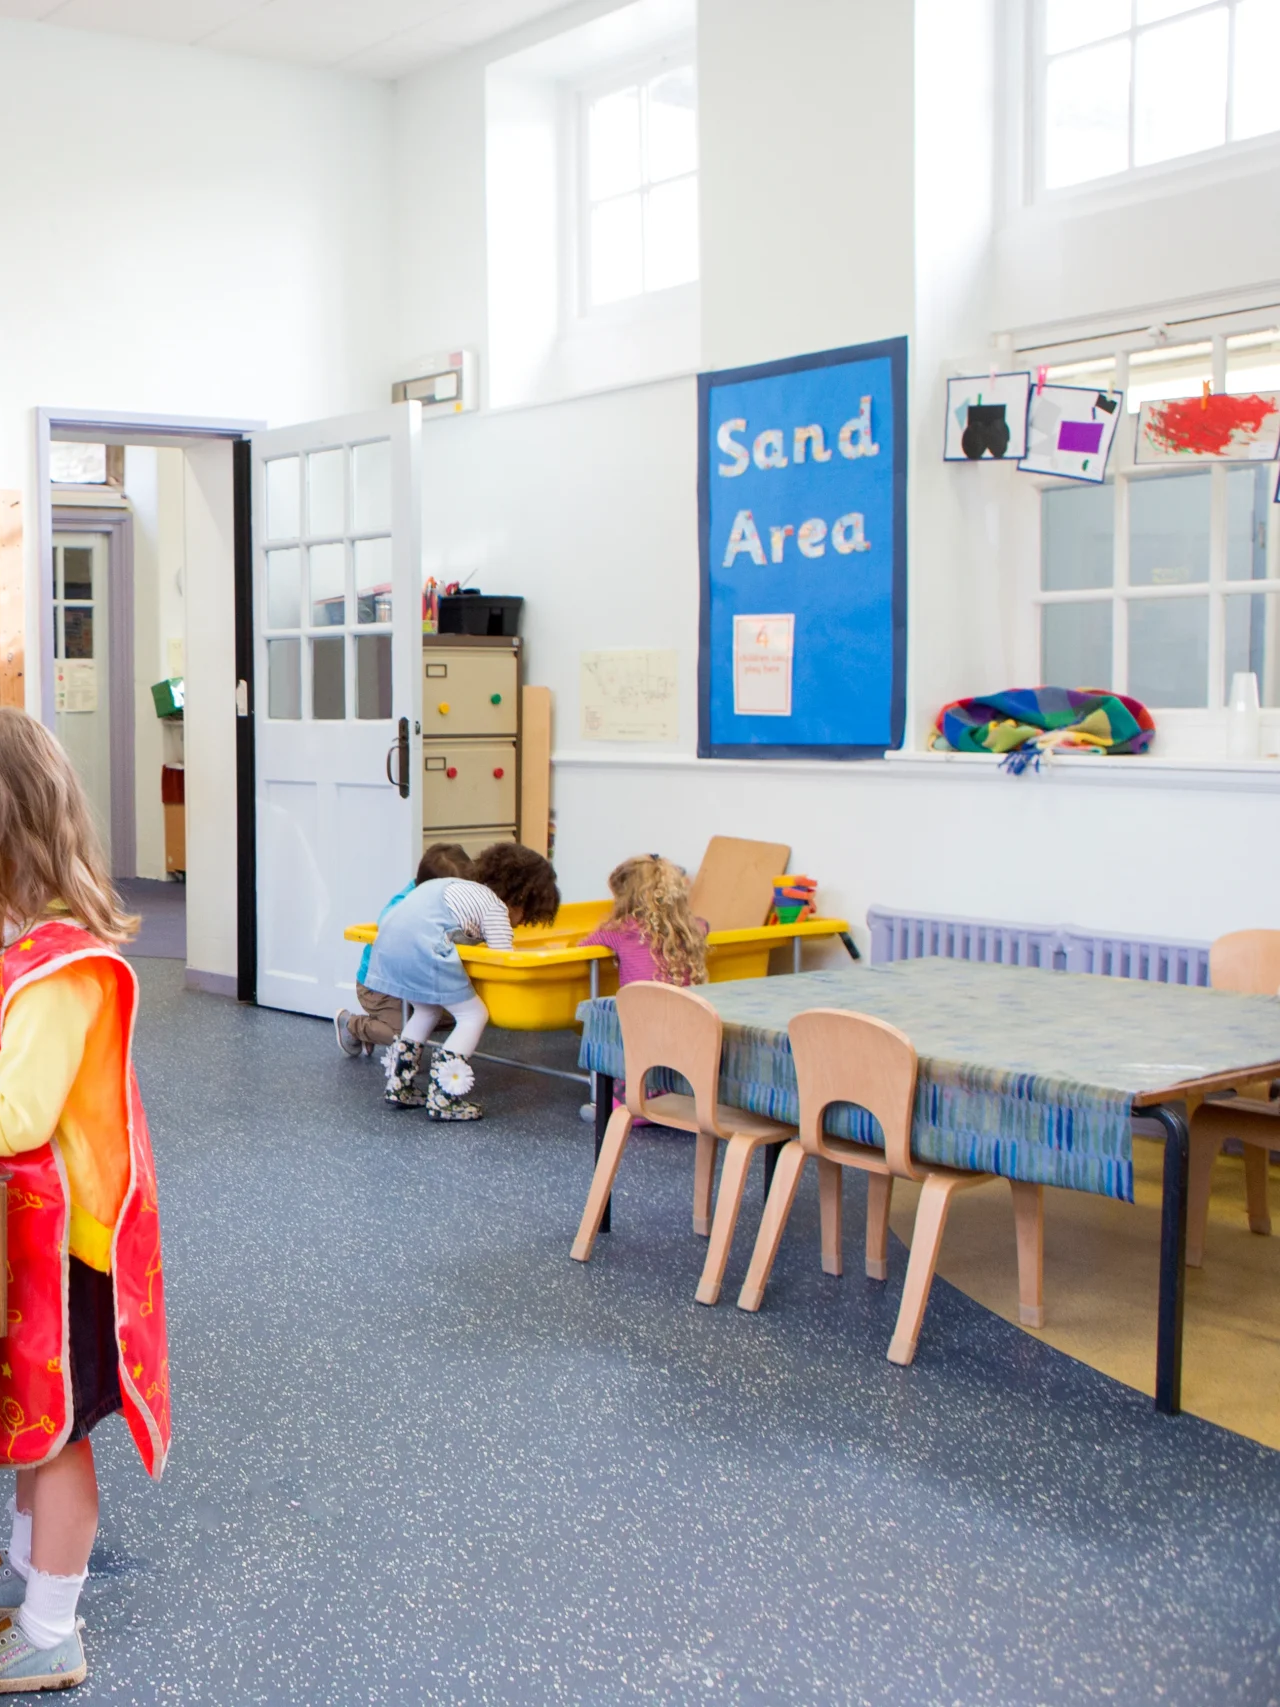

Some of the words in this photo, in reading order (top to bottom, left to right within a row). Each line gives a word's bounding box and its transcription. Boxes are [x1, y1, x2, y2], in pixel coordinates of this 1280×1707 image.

[717, 394, 880, 478] Sand
[722, 509, 871, 568] Area
[755, 624, 770, 649] 4
